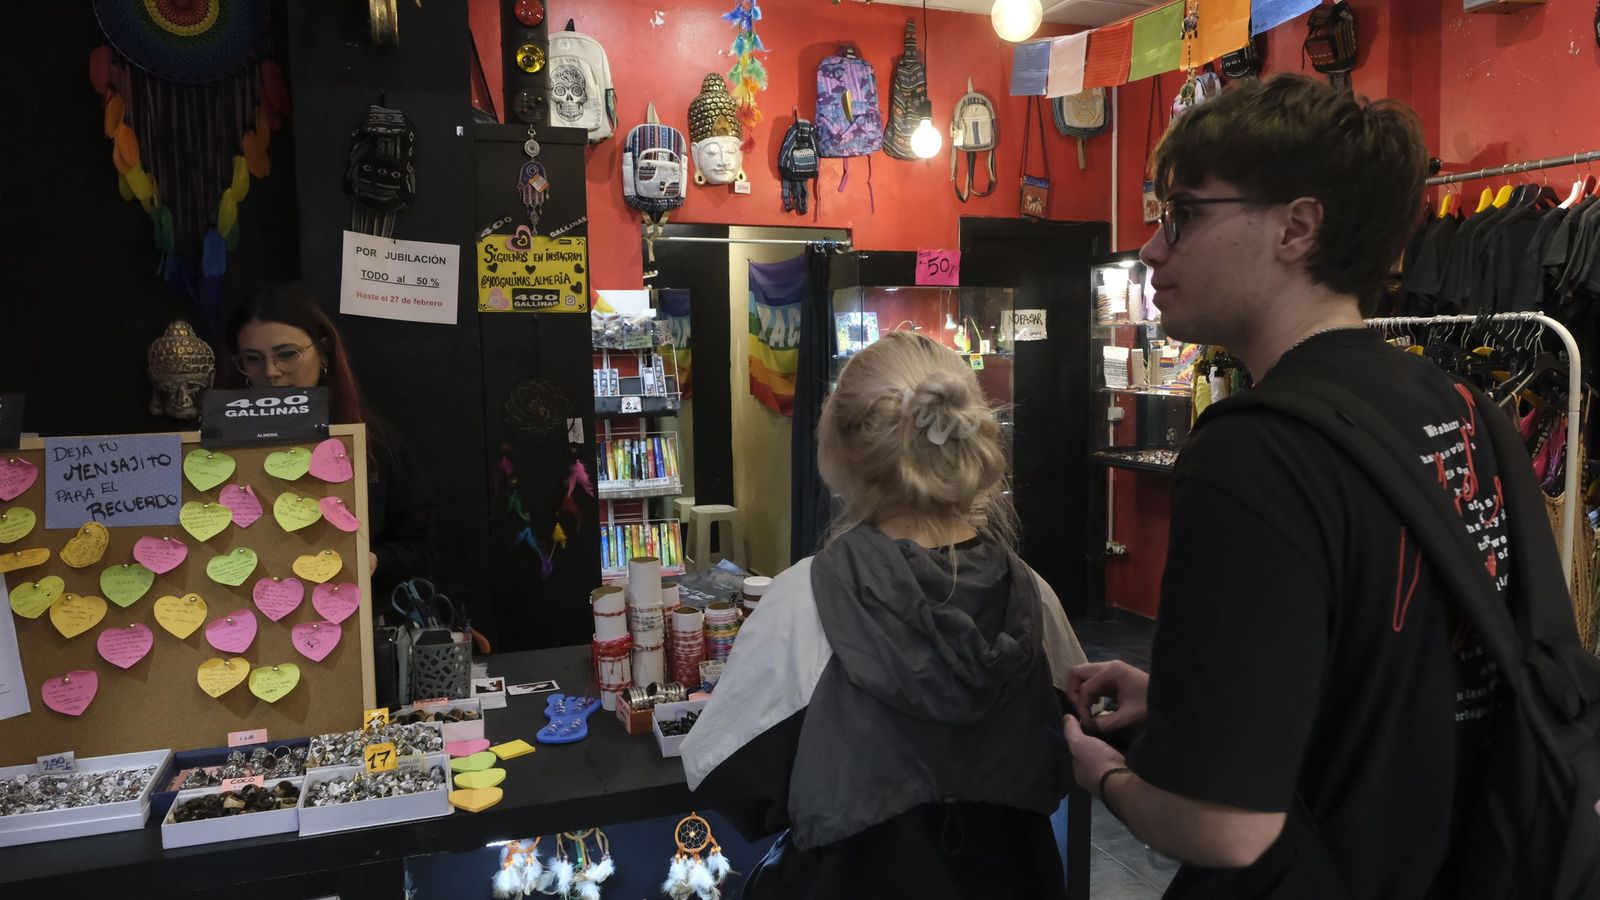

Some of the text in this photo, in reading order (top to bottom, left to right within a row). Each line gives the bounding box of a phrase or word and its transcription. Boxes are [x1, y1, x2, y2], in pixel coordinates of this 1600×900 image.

[550, 216, 587, 237] GALLINAS
[355, 246, 447, 265] POR JUBILACIÓN
[533, 253, 543, 262] EN
[361, 269, 389, 281] TODO
[396, 275, 405, 283] al
[416, 276, 428, 286] 50
[356, 291, 379, 302] Hasta
[390, 295, 400, 303] 27
[401, 296, 411, 305] de
[413, 298, 443, 308] febrero
[225, 394, 309, 408] 400
[224, 405, 310, 418] GALLINAS
[54, 445, 92, 462] DEJA
[55, 481, 119, 503] PARA EL
[86, 494, 179, 522] RECUERDO
[367, 750, 391, 769] 17
